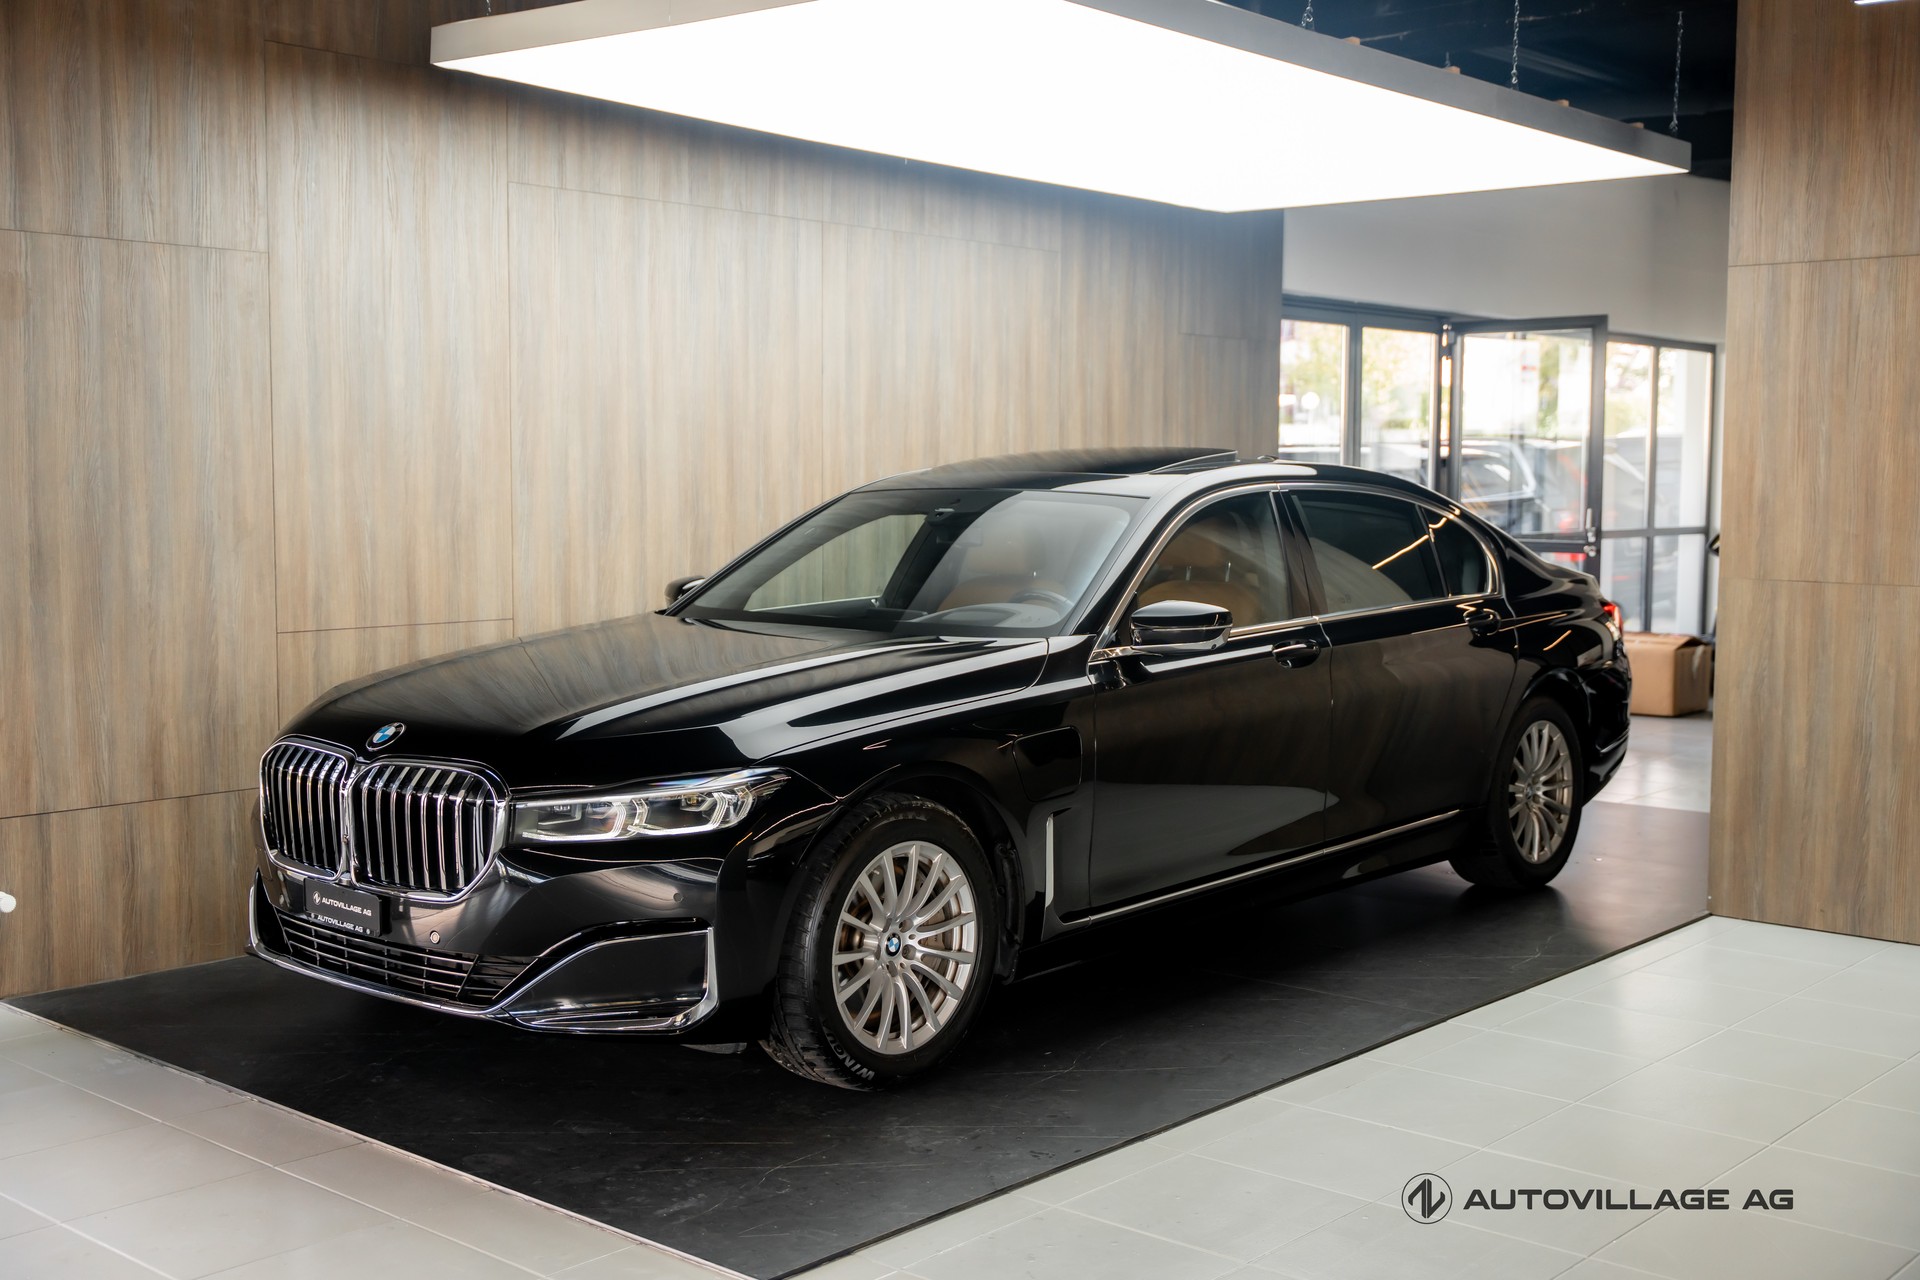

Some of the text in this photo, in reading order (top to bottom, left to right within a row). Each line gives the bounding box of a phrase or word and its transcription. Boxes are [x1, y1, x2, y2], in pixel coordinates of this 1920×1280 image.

[322, 897, 372, 917] AUTOVILLAGE AG
[318, 915, 364, 933] AUTOVILLAGE AG
